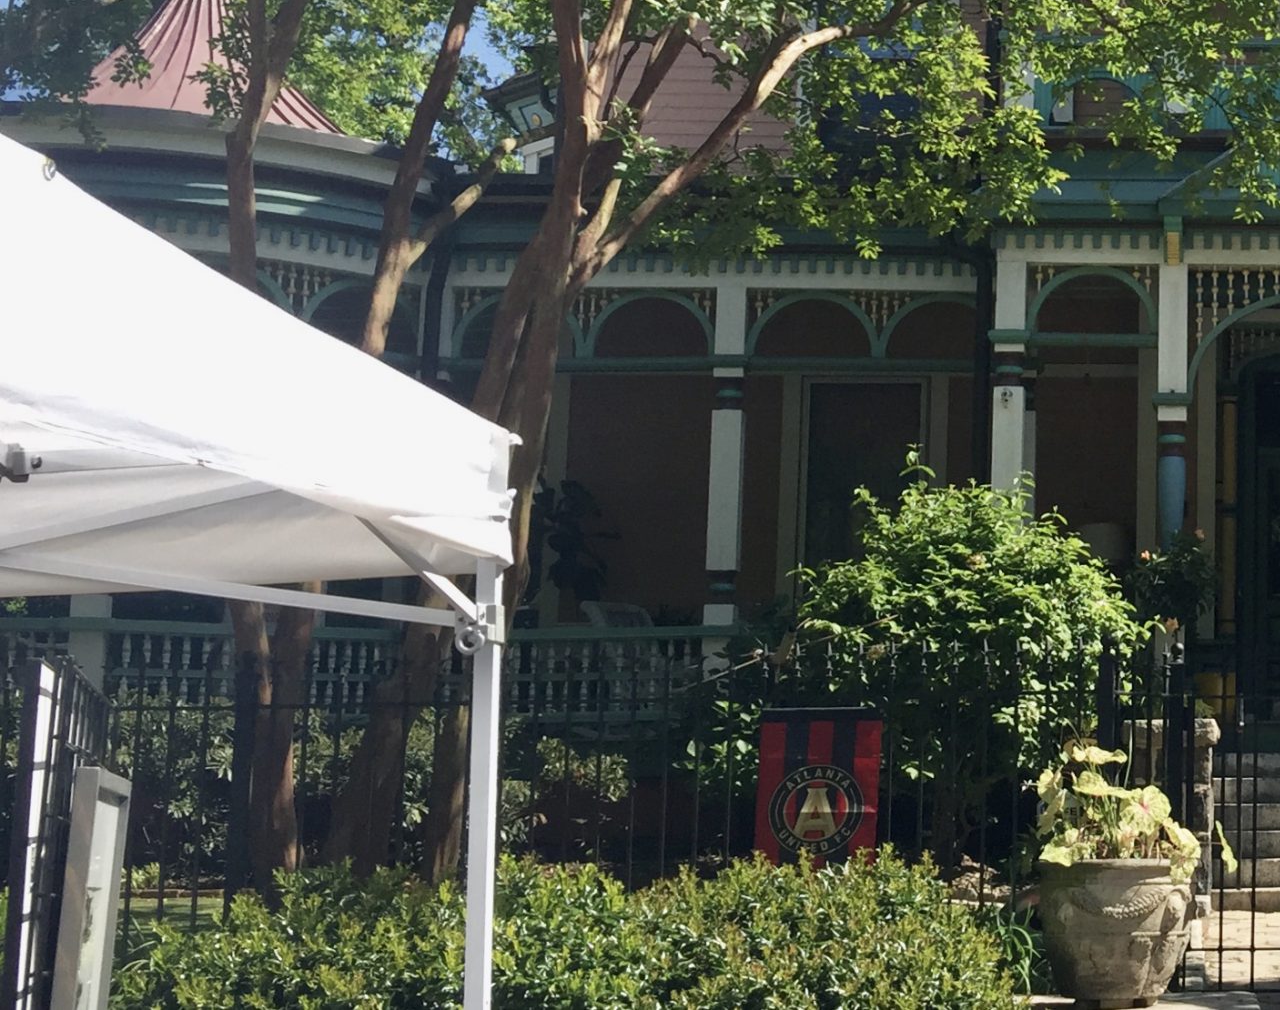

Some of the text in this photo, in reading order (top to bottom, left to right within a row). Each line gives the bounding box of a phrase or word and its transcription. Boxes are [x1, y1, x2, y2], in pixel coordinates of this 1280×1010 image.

[786, 768, 851, 791] ATLANTA
[779, 827, 851, 853] UNITED FC
